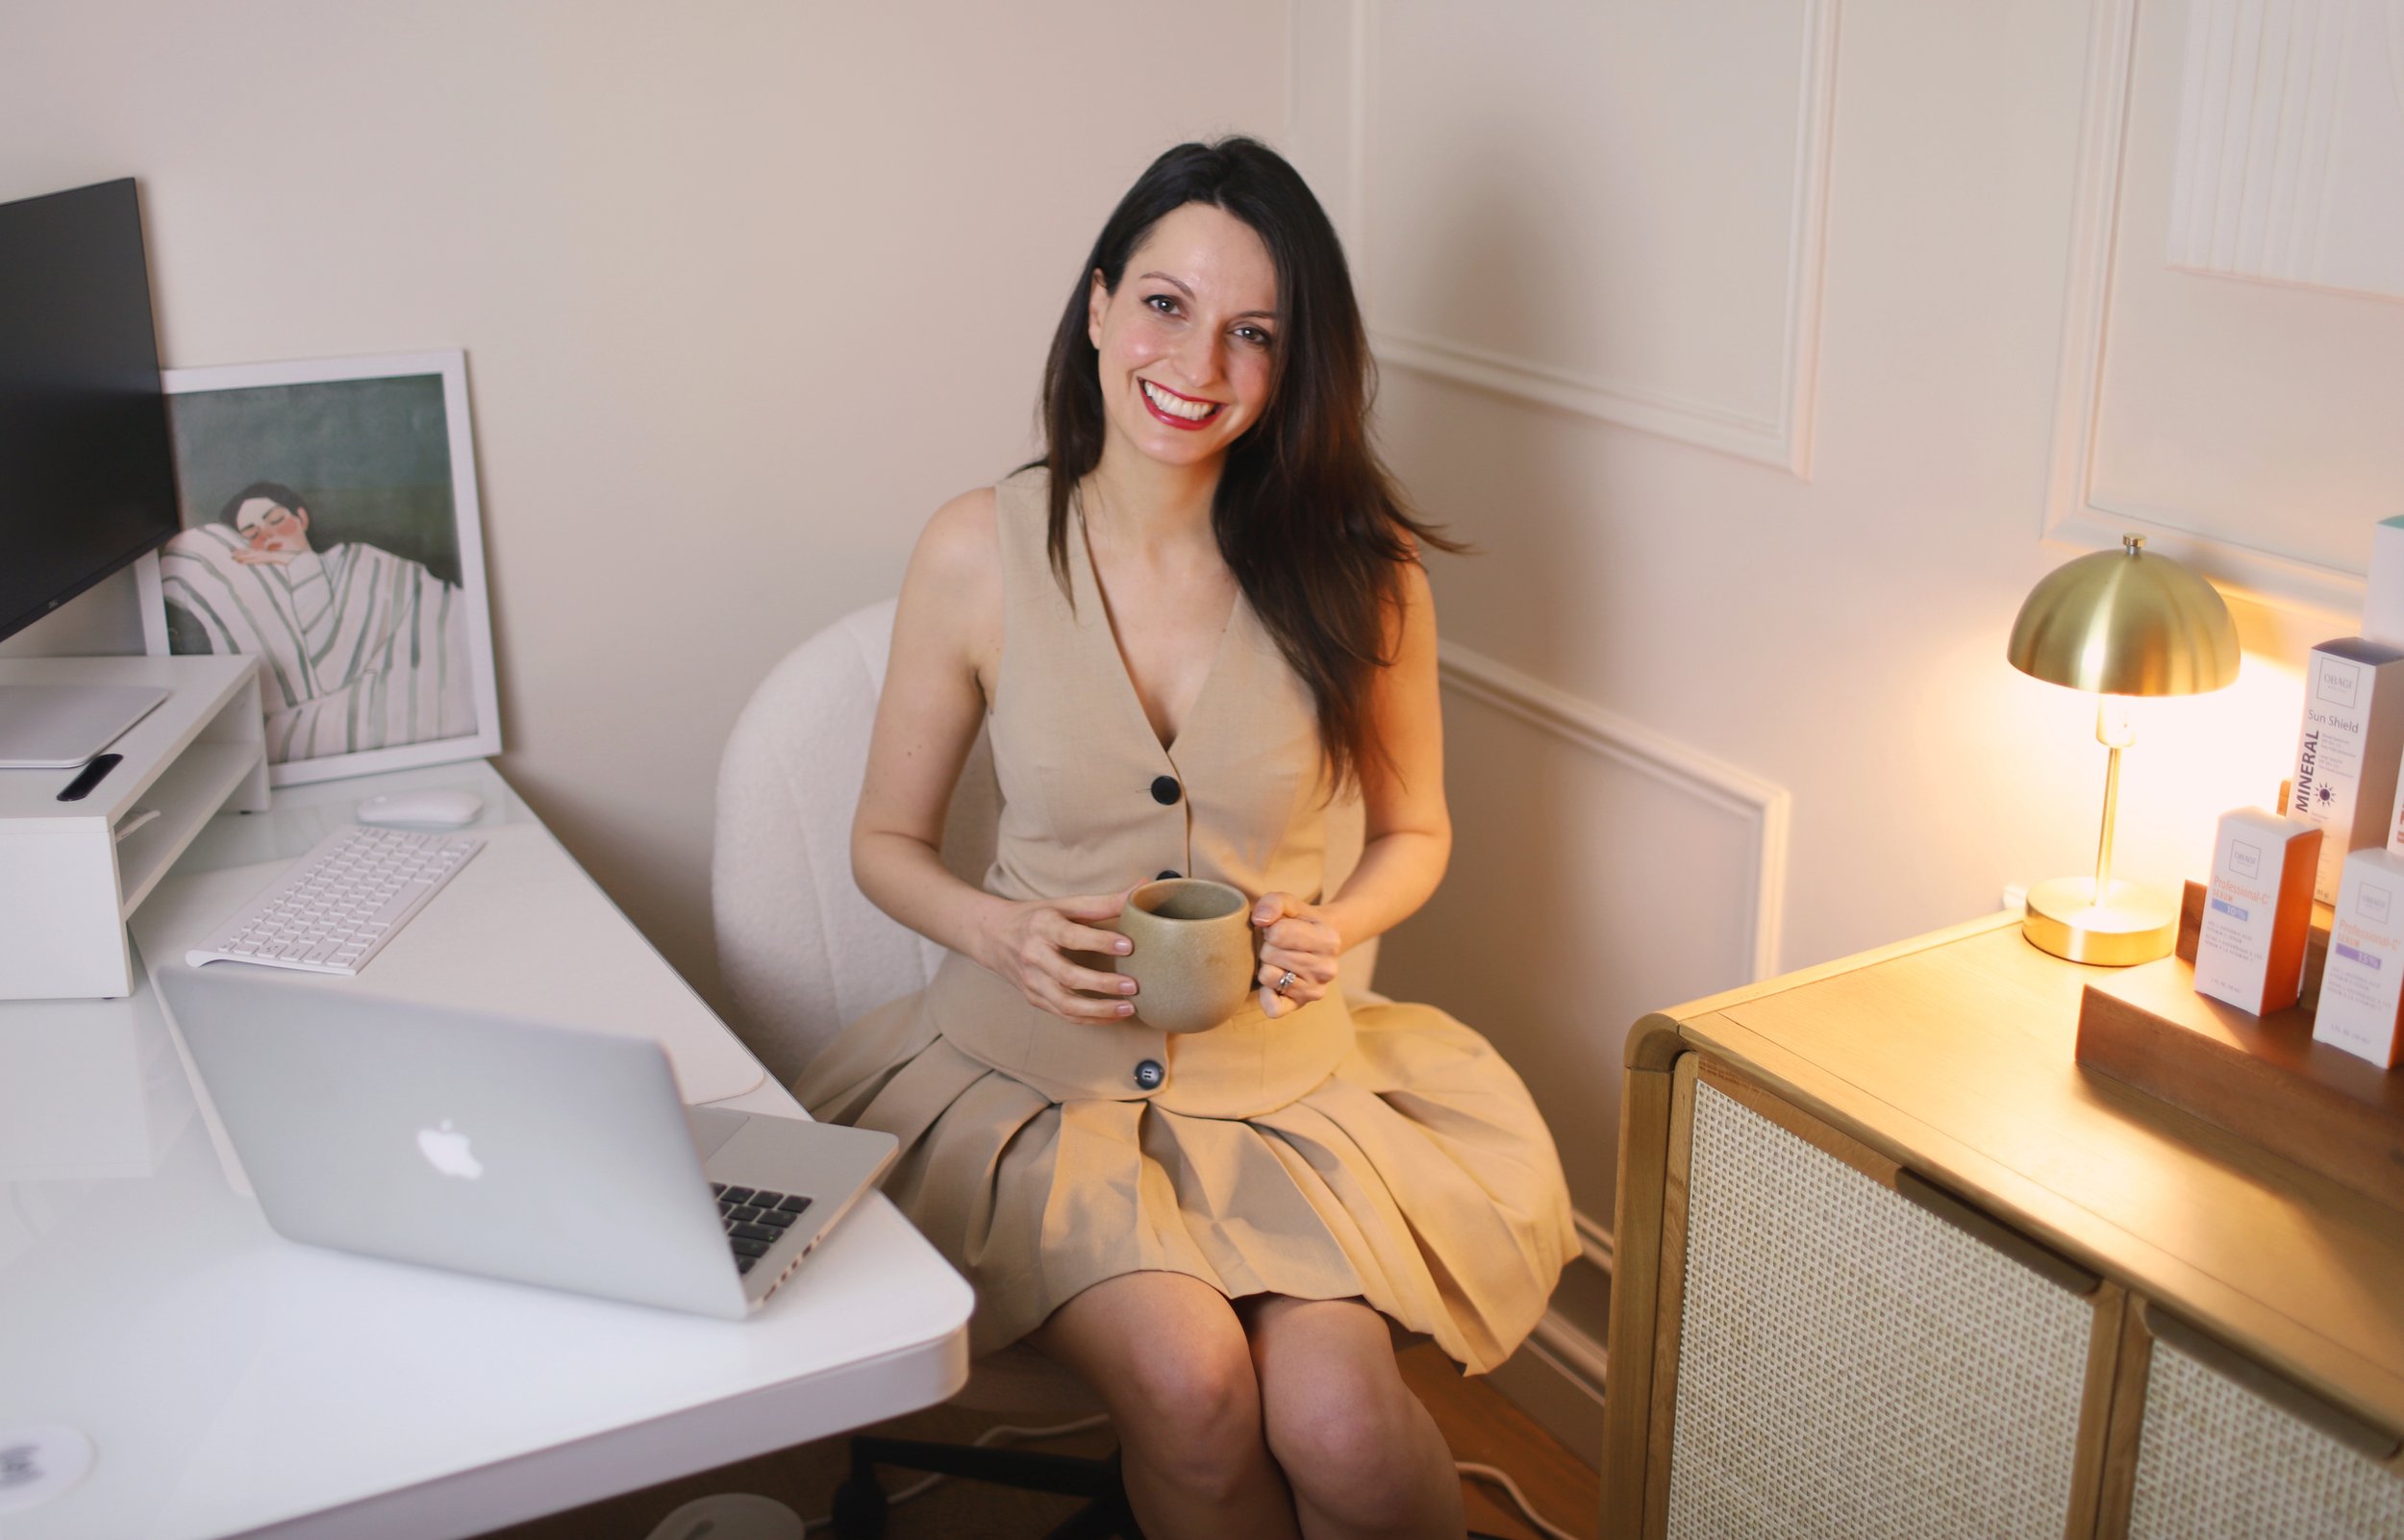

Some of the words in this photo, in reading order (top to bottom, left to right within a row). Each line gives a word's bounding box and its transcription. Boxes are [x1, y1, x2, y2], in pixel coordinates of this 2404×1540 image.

[2323, 673, 2353, 690] OBAGI
[2307, 709, 2326, 725] Sun
[2328, 714, 2359, 733] Shield
[2295, 731, 2319, 813] MINERAL
